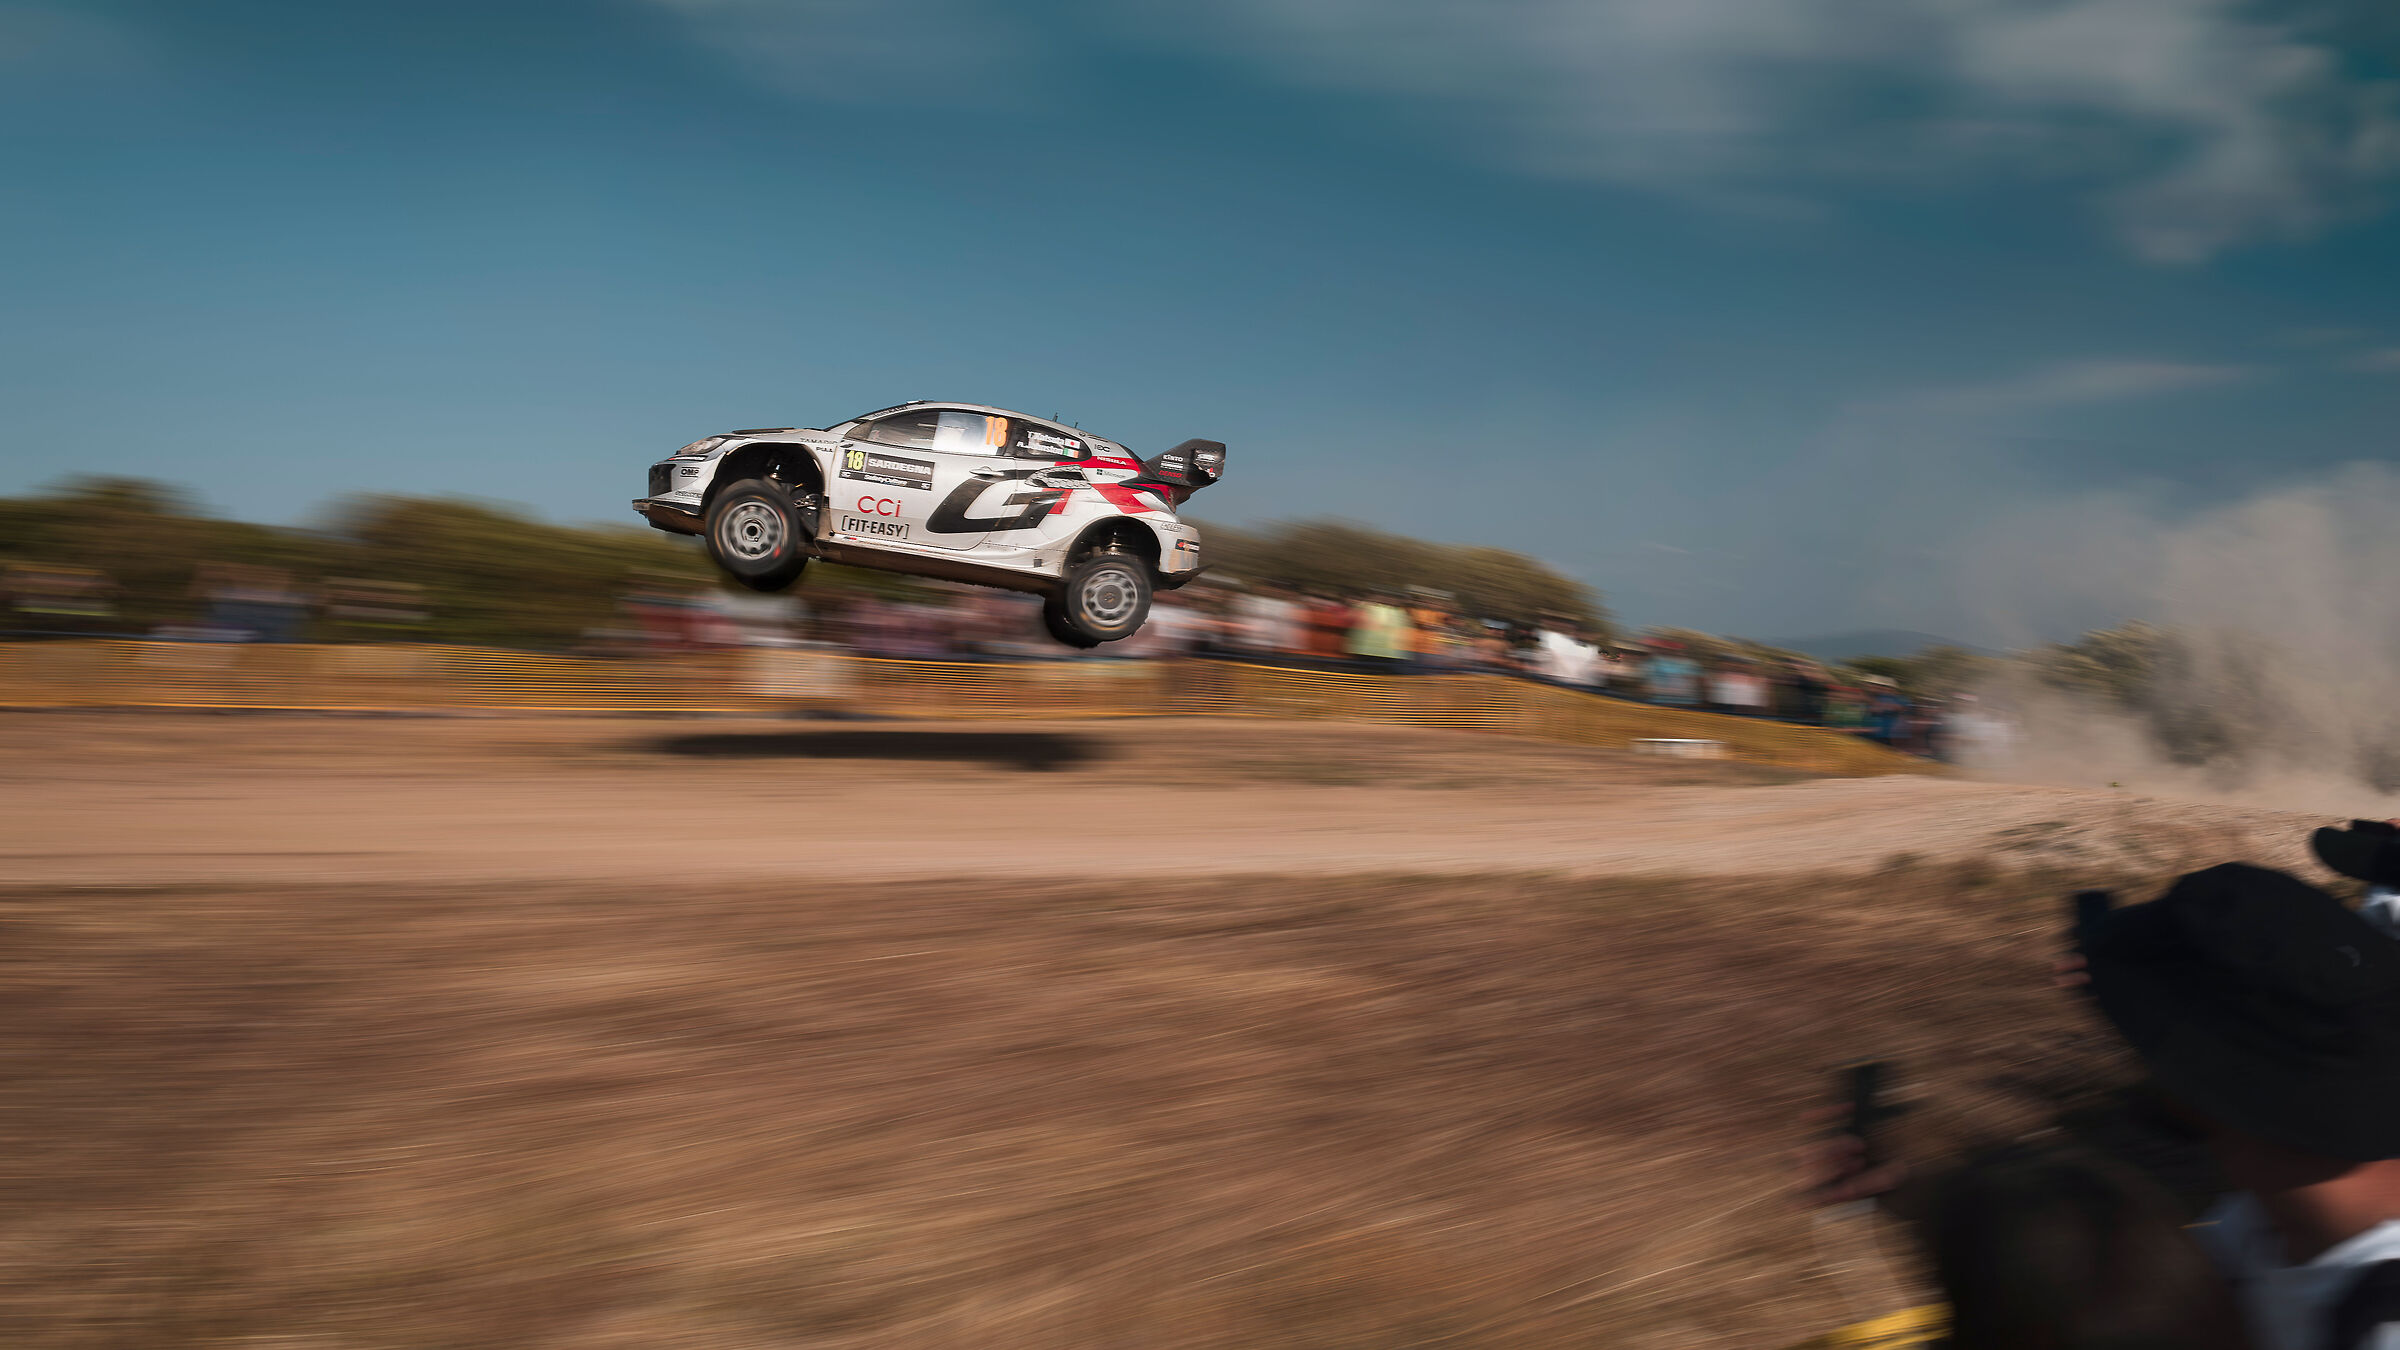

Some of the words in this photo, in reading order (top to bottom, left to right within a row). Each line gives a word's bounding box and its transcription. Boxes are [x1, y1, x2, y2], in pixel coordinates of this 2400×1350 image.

[985, 415, 1008, 448] 18
[680, 468, 699, 476] OMP
[846, 450, 864, 470] 18
[867, 458, 931, 475] SARDEGNA
